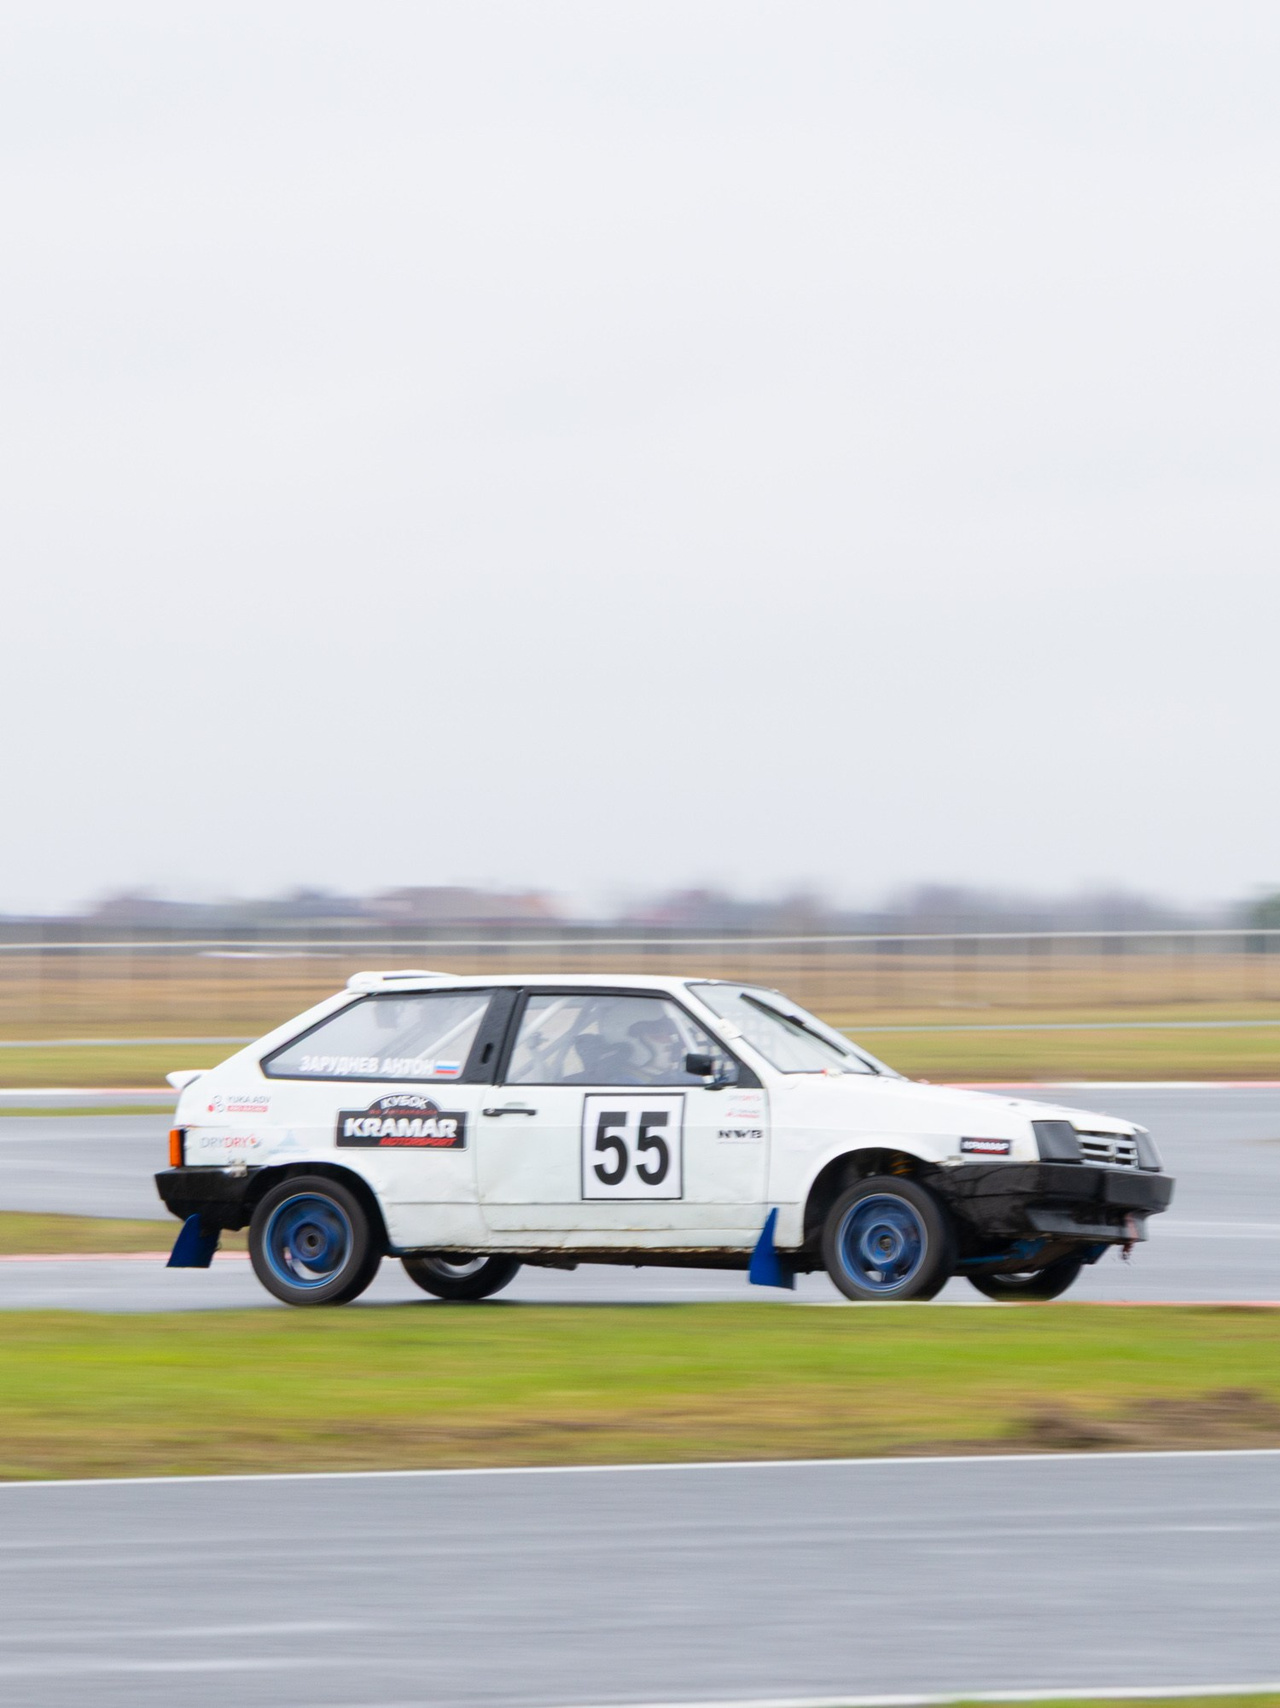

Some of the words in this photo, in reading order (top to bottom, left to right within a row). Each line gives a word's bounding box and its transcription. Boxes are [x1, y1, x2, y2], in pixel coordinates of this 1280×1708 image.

[299, 1055, 379, 1075] ЗАРУДНЕВ
[379, 1058, 434, 1077] АНТОН
[380, 1095, 429, 1110] КУБОК
[344, 1118, 457, 1138] KRAMAR
[379, 1138, 457, 1146] MOTORSPORT
[593, 1111, 669, 1186] 55
